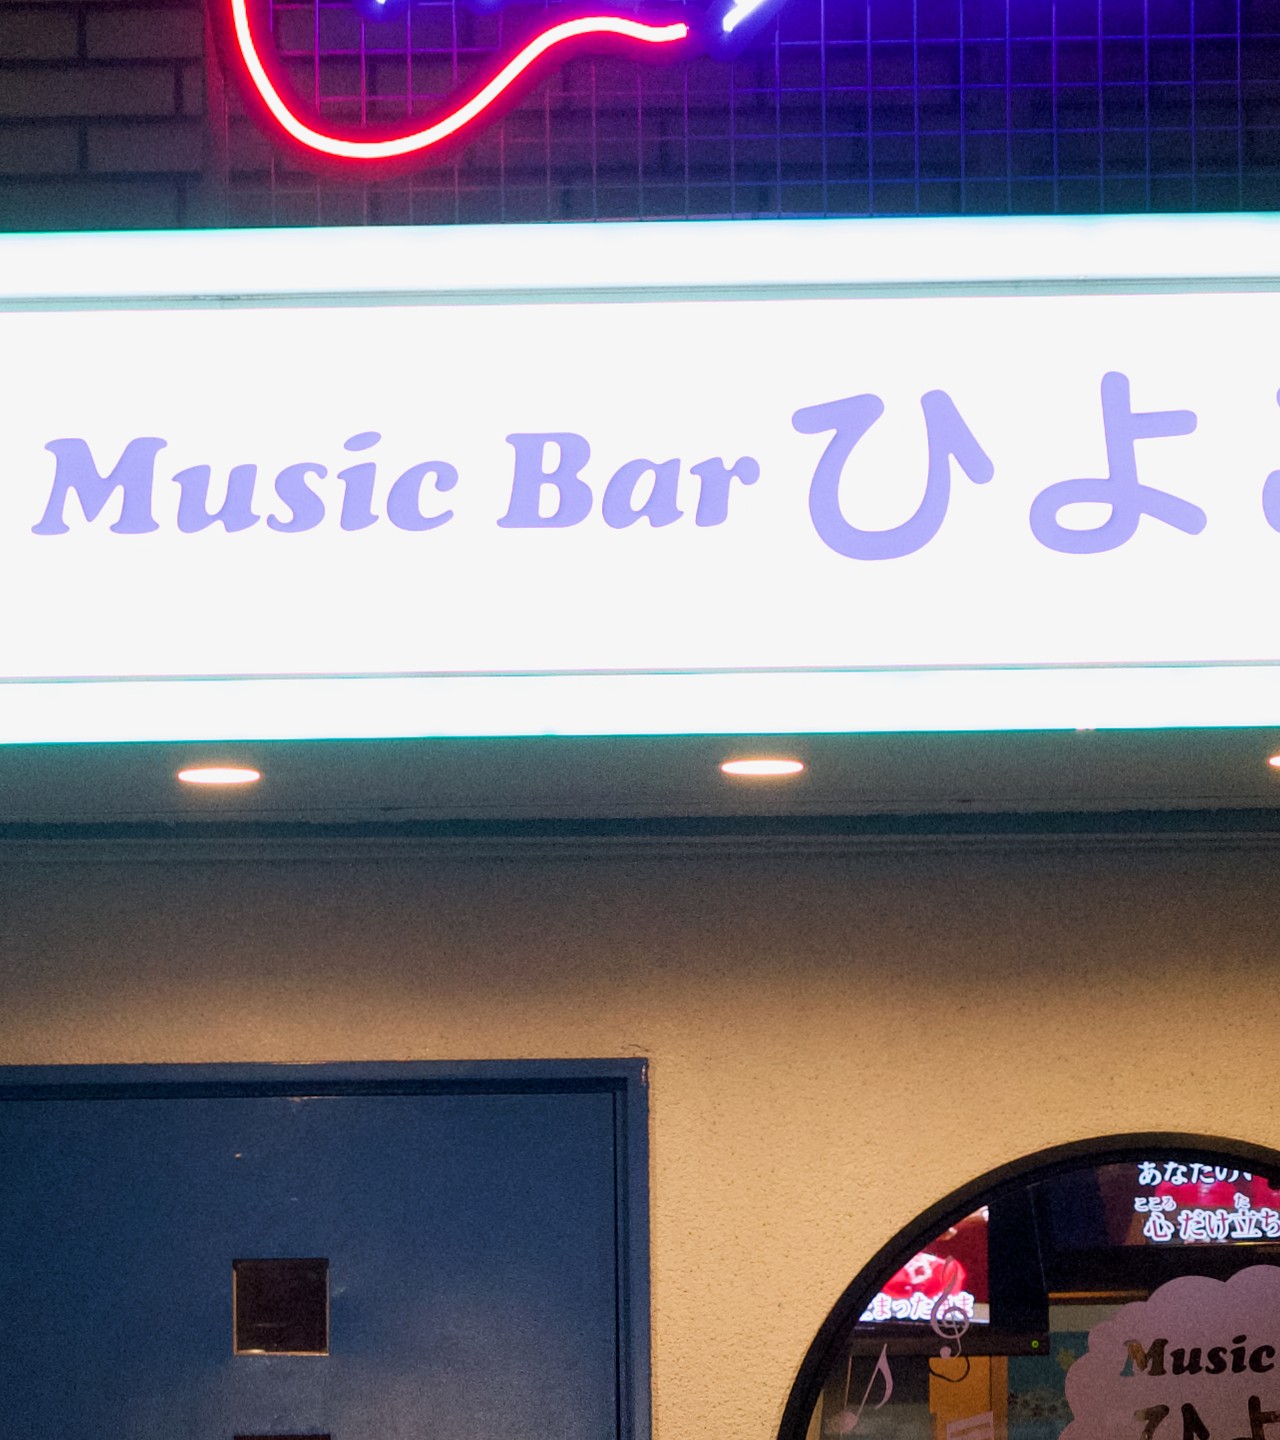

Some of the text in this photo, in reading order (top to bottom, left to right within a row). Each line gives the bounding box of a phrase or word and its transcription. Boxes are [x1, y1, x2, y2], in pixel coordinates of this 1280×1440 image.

[30, 430, 460, 536] Music
[496, 431, 761, 530] Bar
[1136, 1160, 1254, 1187] あなたの
[1120, 1334, 1277, 1378] Music
